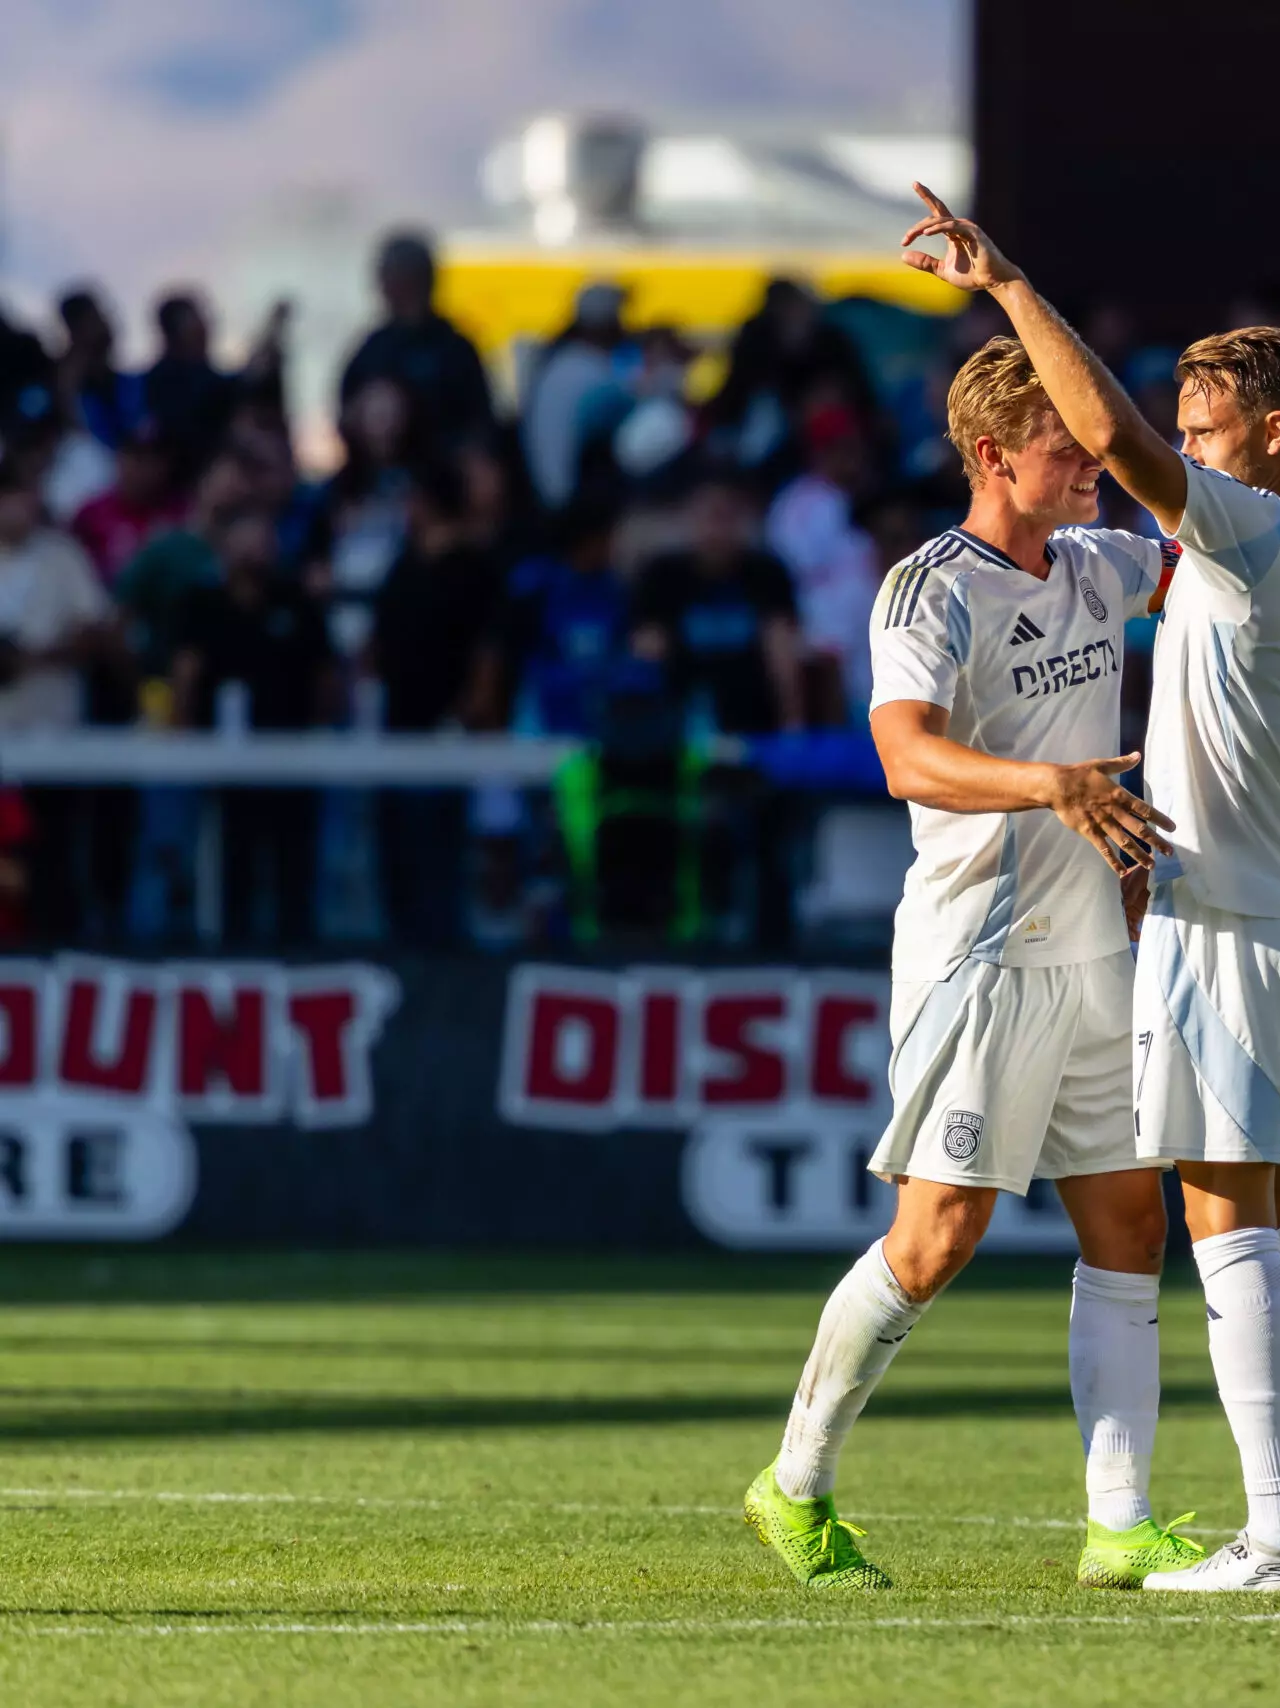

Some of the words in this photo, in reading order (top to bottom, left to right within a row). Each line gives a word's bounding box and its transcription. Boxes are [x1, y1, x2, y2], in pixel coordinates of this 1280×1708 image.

[524, 990, 879, 1106] DISC
[948, 1113, 962, 1123] SAN
[962, 1114, 981, 1129] DIEGO
